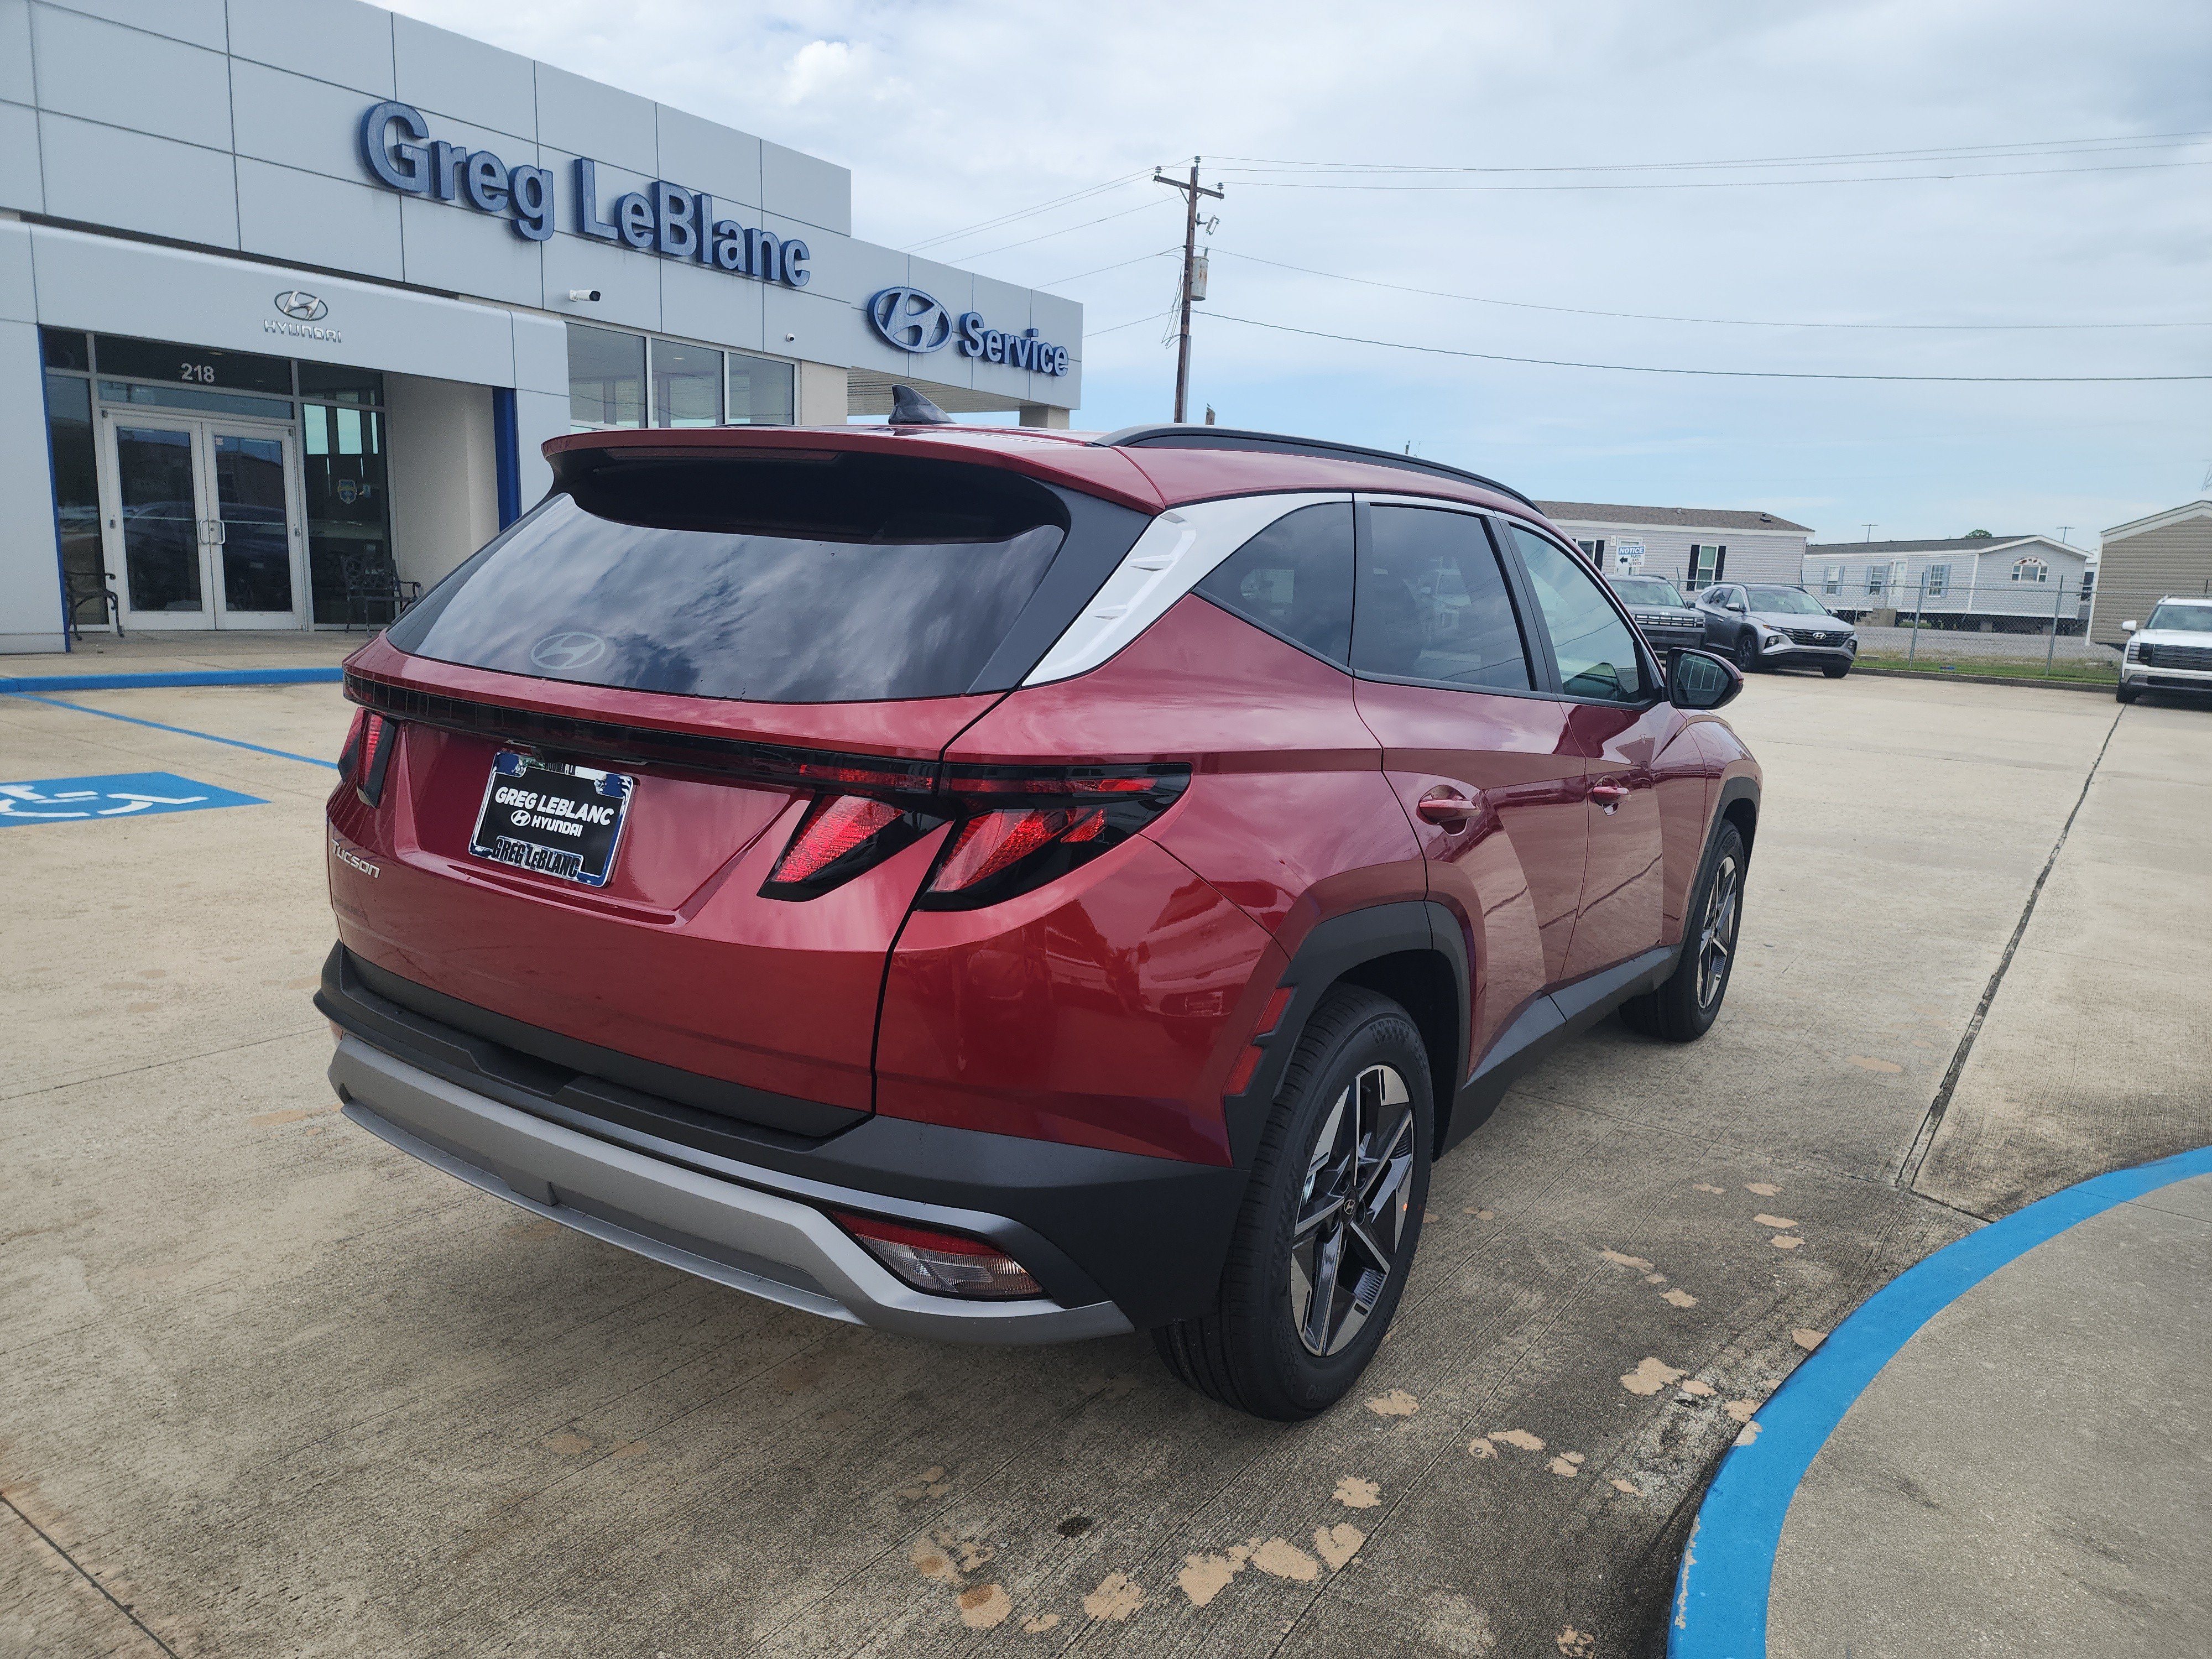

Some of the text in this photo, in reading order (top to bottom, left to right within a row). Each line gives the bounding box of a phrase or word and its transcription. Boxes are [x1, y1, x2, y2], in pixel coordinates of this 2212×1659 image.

[360, 101, 811, 287] Greg LeBlanc
[264, 319, 341, 343] HYUNDAI
[958, 311, 1069, 376] Service
[181, 362, 215, 383] 218
[495, 786, 614, 826] GREG LEBLANC
[531, 815, 583, 837] HYUNDAI
[491, 838, 527, 864] GREG
